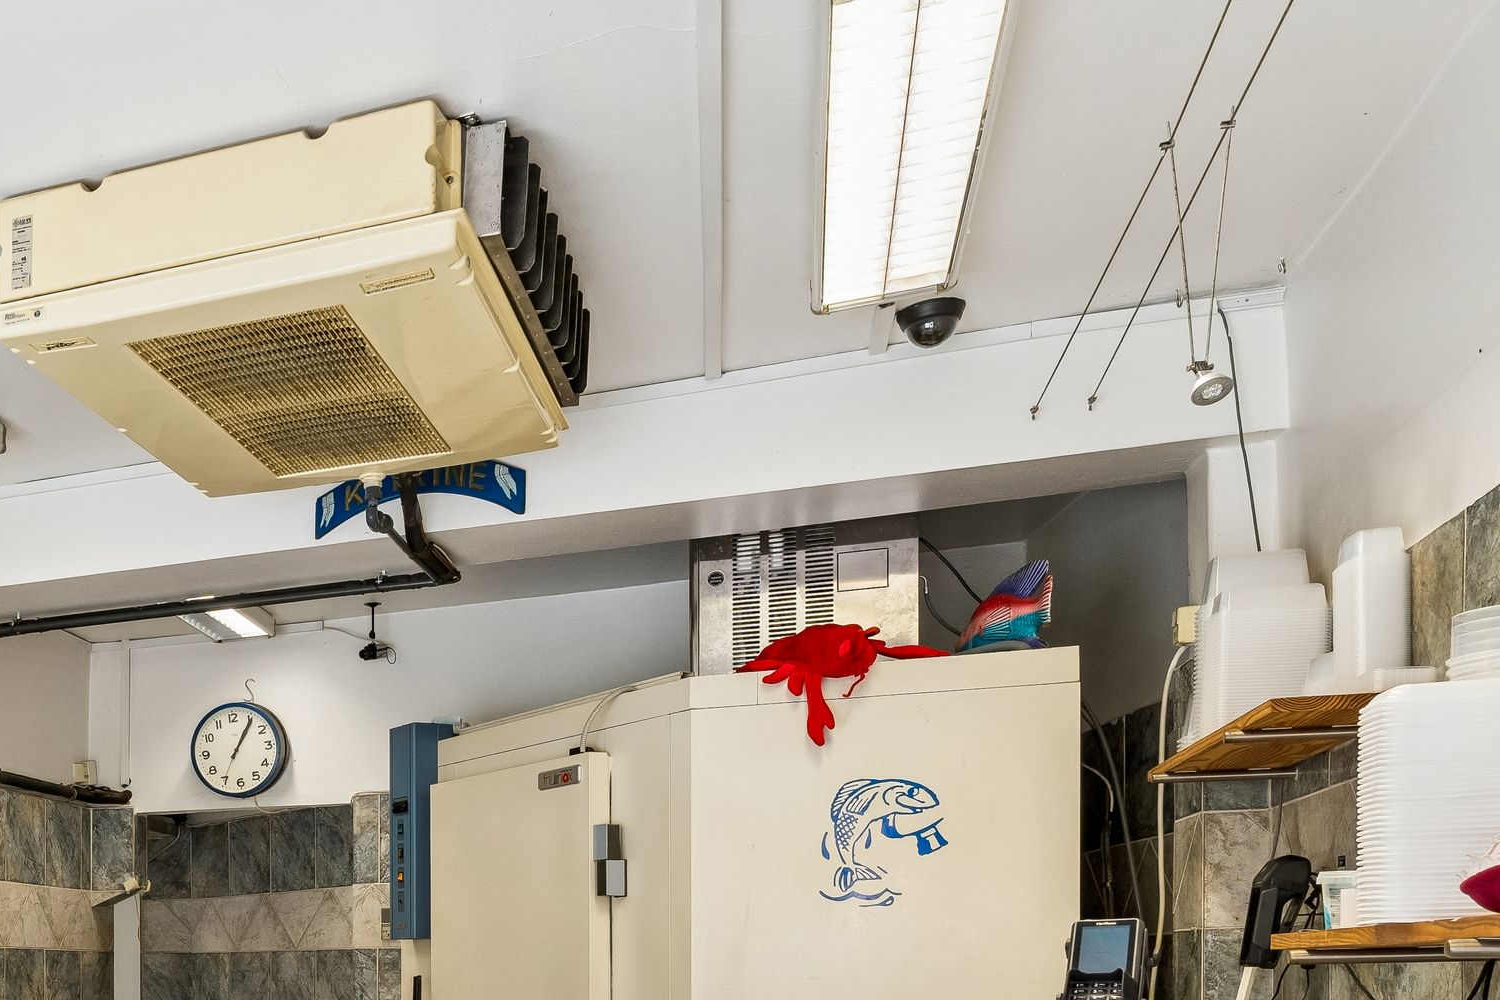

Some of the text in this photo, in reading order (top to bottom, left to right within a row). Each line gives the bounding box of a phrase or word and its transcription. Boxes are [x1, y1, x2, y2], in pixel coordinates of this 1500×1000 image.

[228, 713, 238, 723] 12
[215, 720, 222, 730] 11
[257, 725, 267, 735] 2
[204, 733, 214, 743] 10
[264, 740, 273, 750] 3
[201, 750, 210, 760] 9
[260, 758, 269, 767] 4
[208, 765, 218, 775] 8
[220, 775, 229, 785] 7
[251, 771, 260, 781] 5
[236, 777, 245, 788] 6
